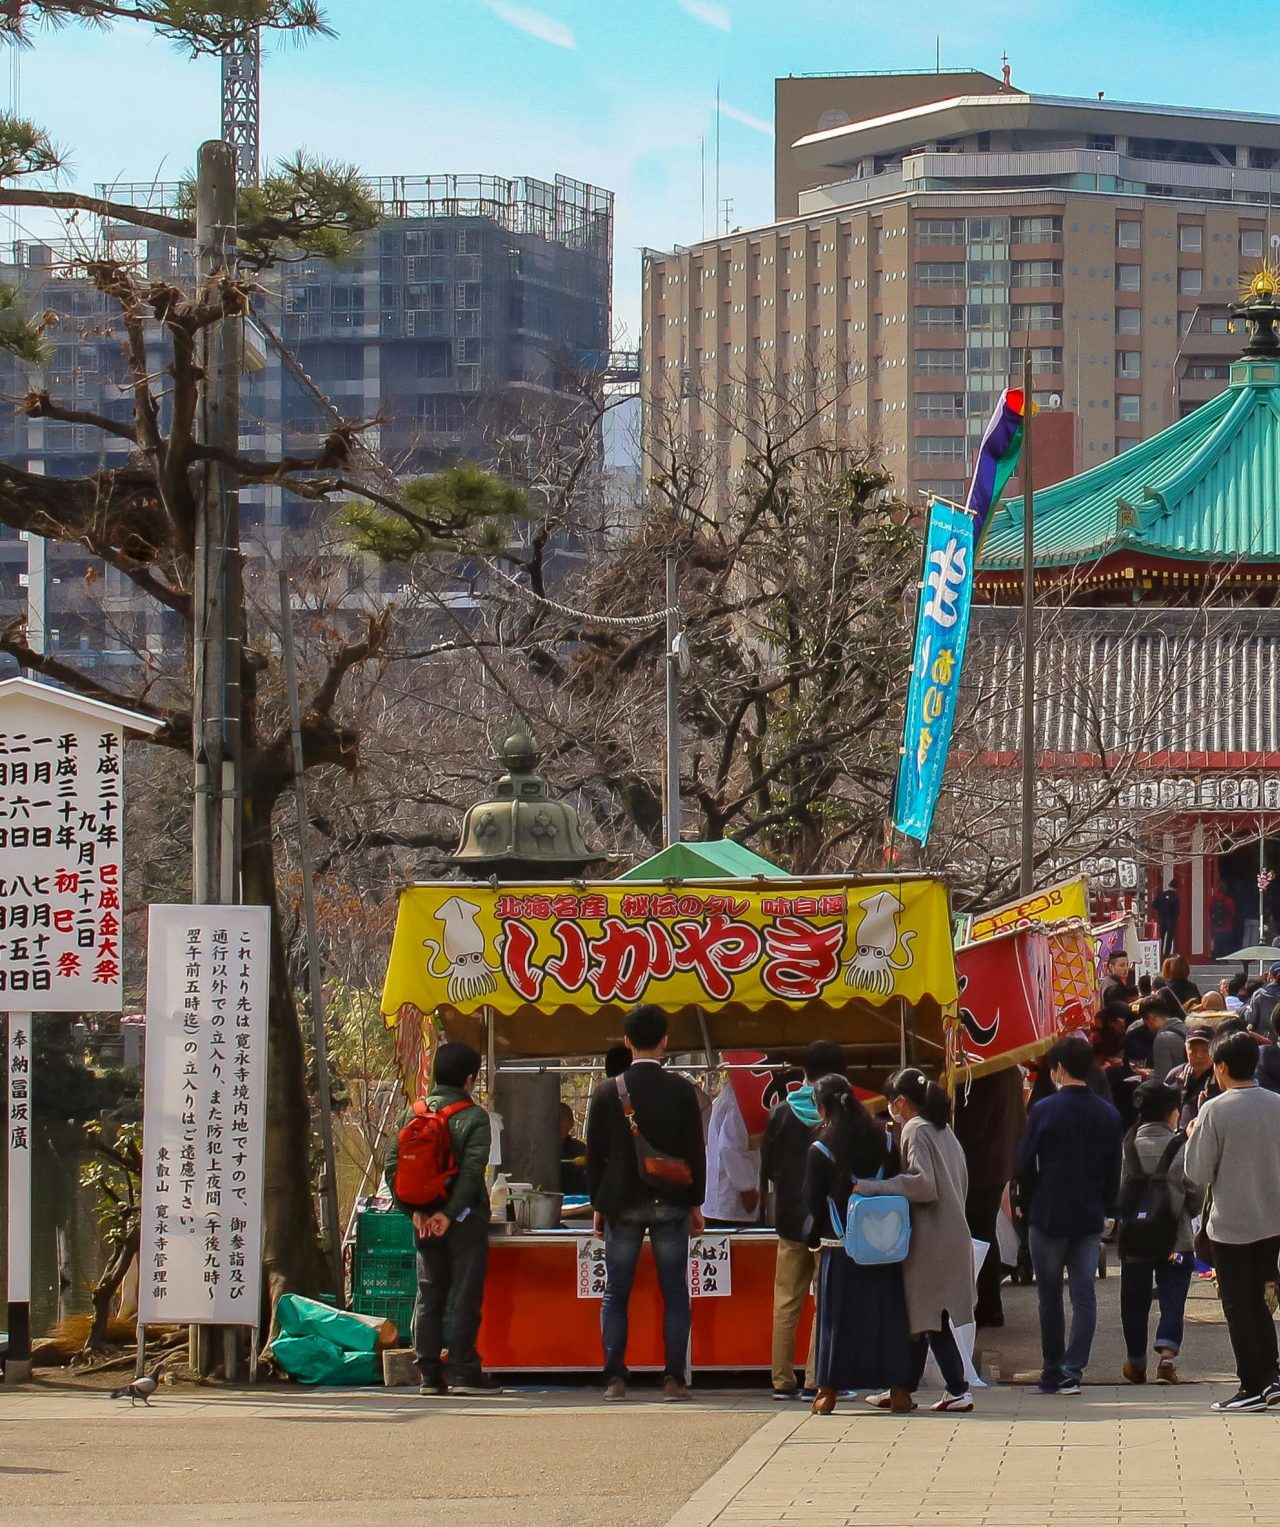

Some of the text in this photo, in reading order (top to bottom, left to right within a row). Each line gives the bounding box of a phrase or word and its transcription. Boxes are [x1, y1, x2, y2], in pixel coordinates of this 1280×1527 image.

[55, 733, 78, 850] 平成三十年
[96, 733, 119, 849] 平成三十年
[9, 734, 32, 991] 二月六日 八月五日
[501, 915, 846, 1001] いかやき
[702, 1246, 718, 1292] はんみ
[718, 1238, 728, 1261] イカ
